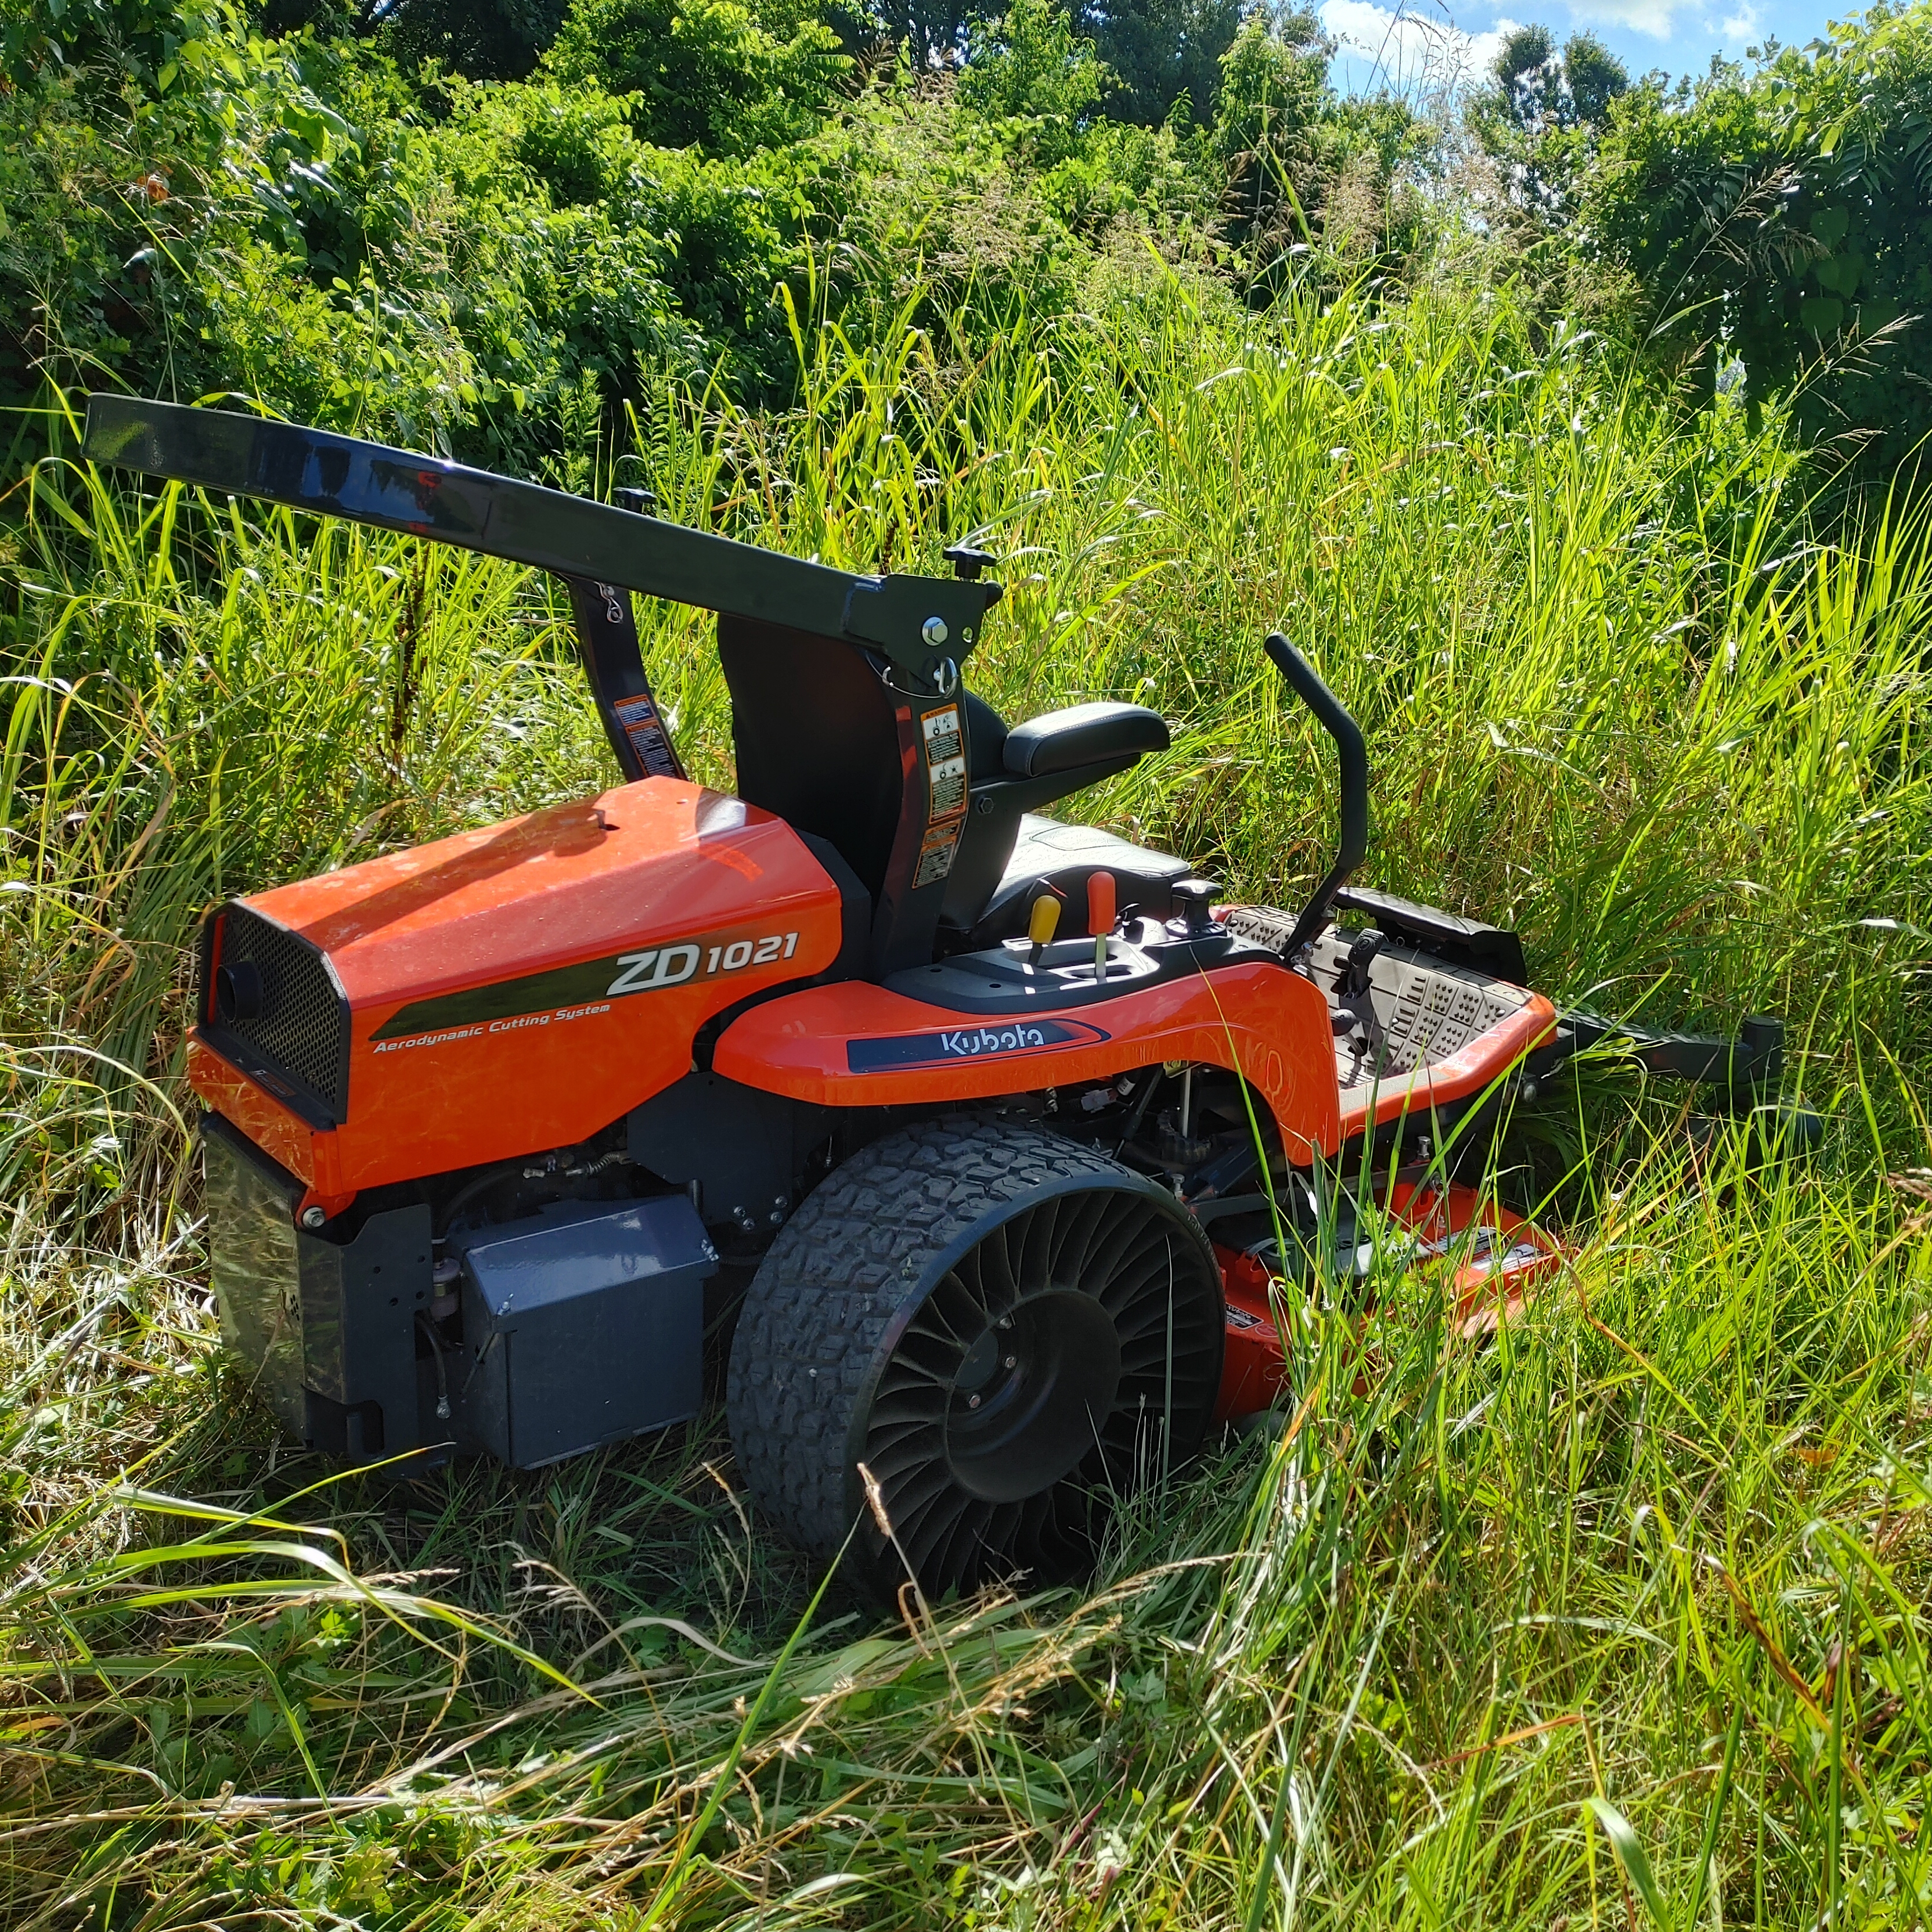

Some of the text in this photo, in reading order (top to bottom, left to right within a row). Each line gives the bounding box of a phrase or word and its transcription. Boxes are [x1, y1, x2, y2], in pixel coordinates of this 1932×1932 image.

[606, 932, 799, 996] ZD 1021
[373, 1004, 610, 1053] Aerodynamic Cutting System
[940, 1024, 1044, 1055] Kubota
